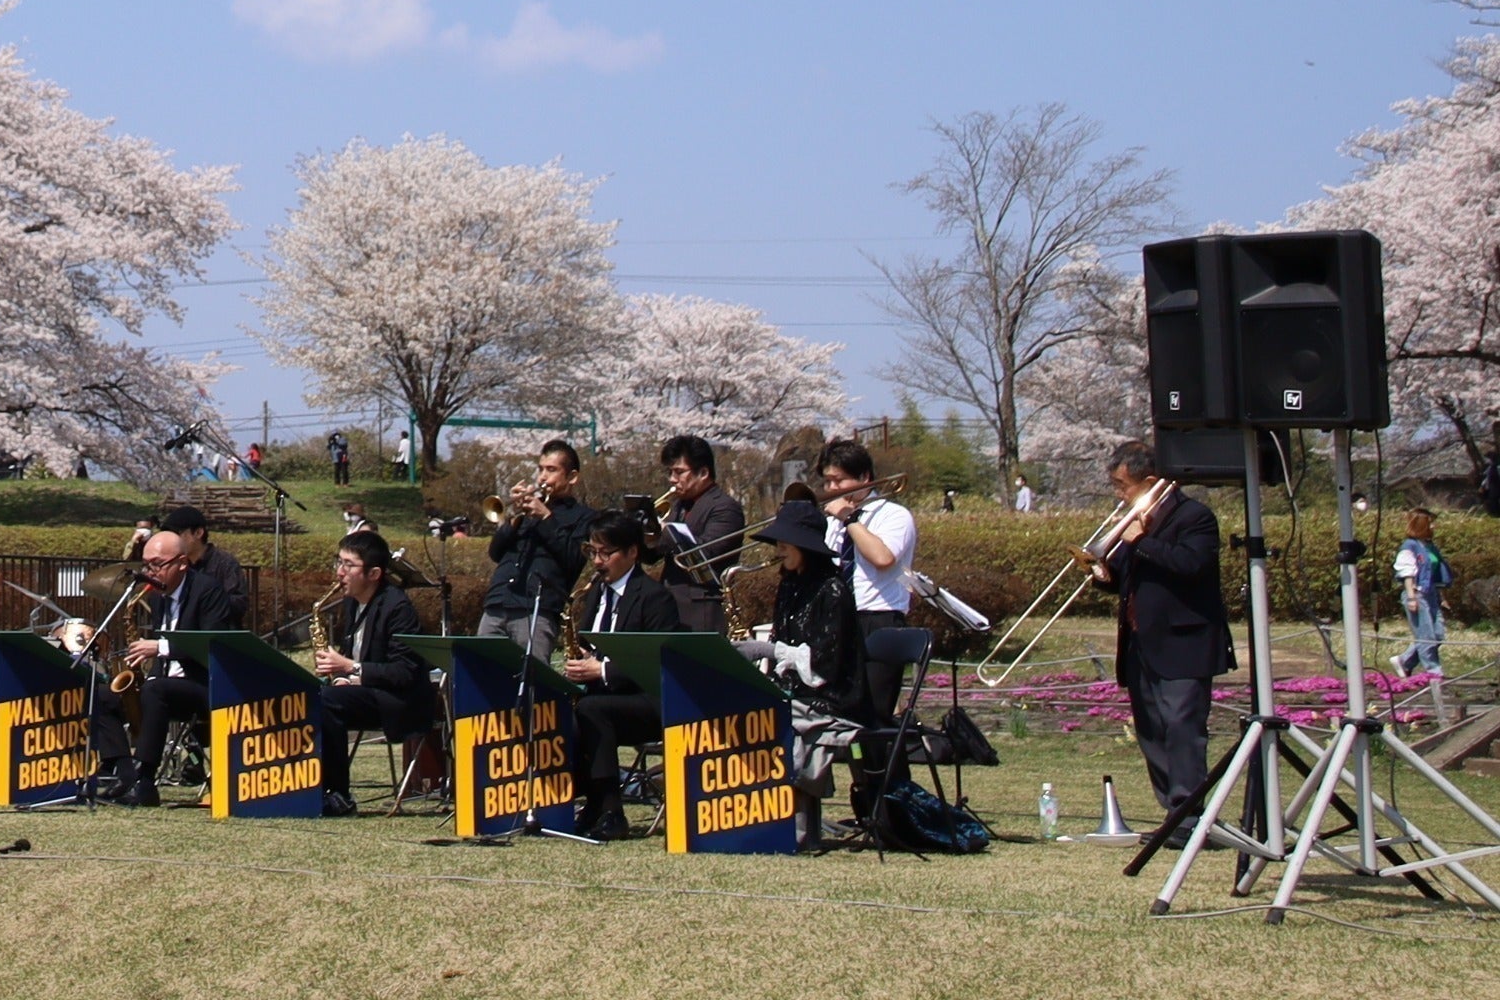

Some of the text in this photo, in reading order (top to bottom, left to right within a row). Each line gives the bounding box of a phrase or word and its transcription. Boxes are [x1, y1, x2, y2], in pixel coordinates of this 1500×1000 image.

[7, 687, 84, 726] WALK ON
[224, 692, 306, 735] WALK ON
[470, 707, 524, 746] WALK
[23, 718, 90, 757] CLOUDS
[242, 724, 314, 766] CLOUDS
[681, 707, 775, 756] WALK ON
[238, 758, 320, 802] BIGBAND
[701, 746, 785, 793] CLOUDS
[484, 772, 573, 819] BIGBAND
[697, 785, 794, 834] BIGBAND
